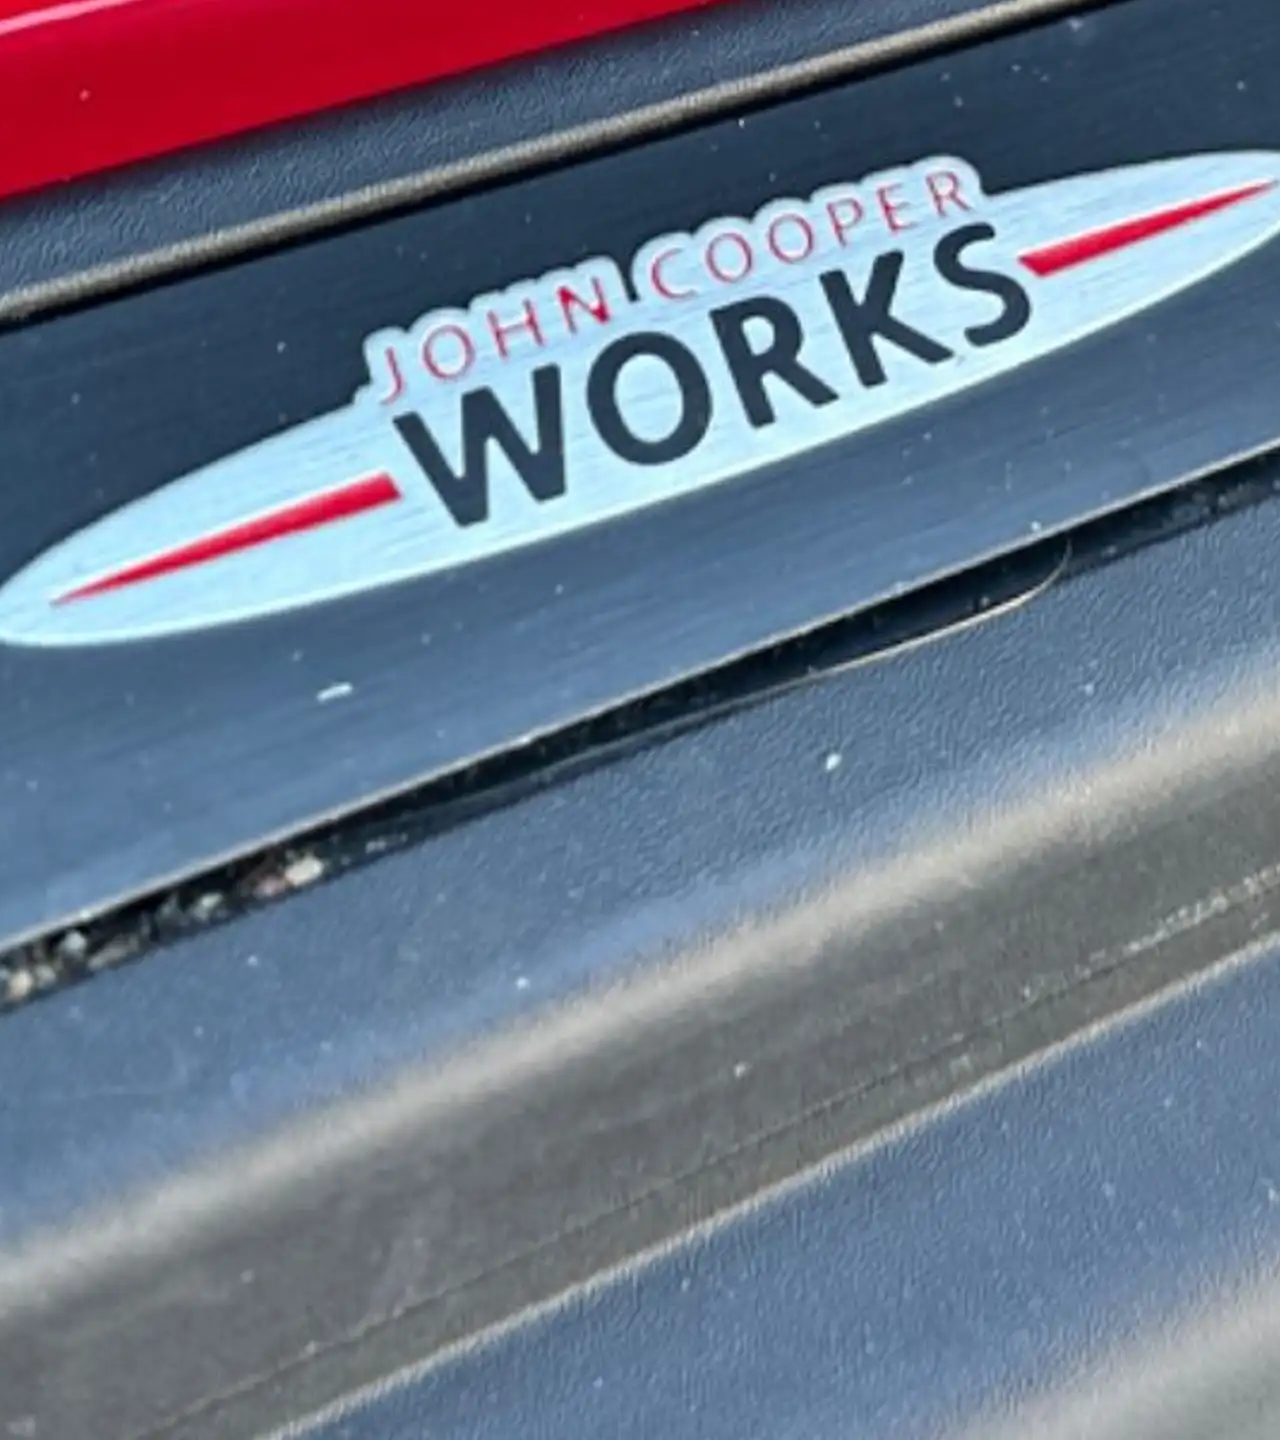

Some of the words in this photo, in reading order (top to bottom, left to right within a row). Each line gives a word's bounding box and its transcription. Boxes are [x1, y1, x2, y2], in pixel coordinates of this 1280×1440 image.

[380, 276, 612, 403] JOHN
[650, 170, 973, 301] COOPER
[395, 224, 1032, 527] WORKS
